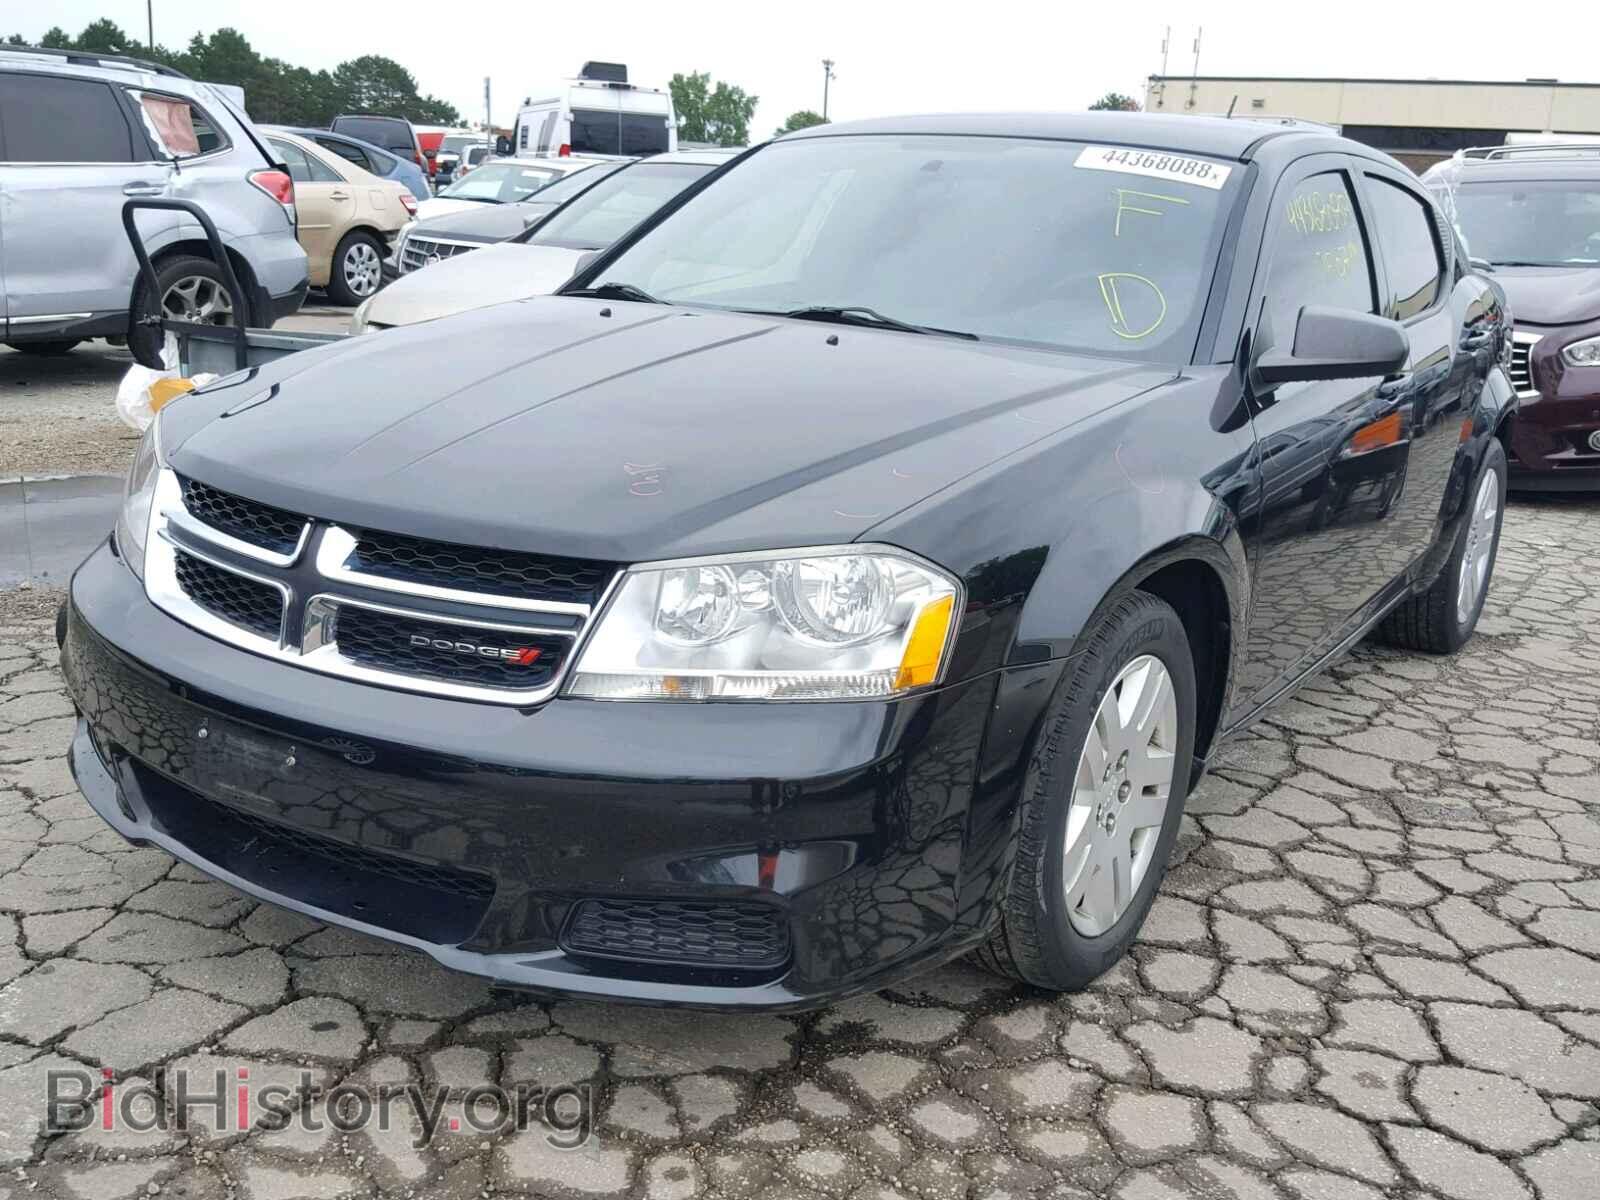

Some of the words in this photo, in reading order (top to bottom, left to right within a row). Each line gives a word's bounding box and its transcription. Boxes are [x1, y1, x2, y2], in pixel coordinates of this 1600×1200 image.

[1101, 150, 1213, 179] 44368088
[1111, 188, 1191, 237] F
[1097, 272, 1167, 340] D
[410, 634, 521, 660] DODGE
